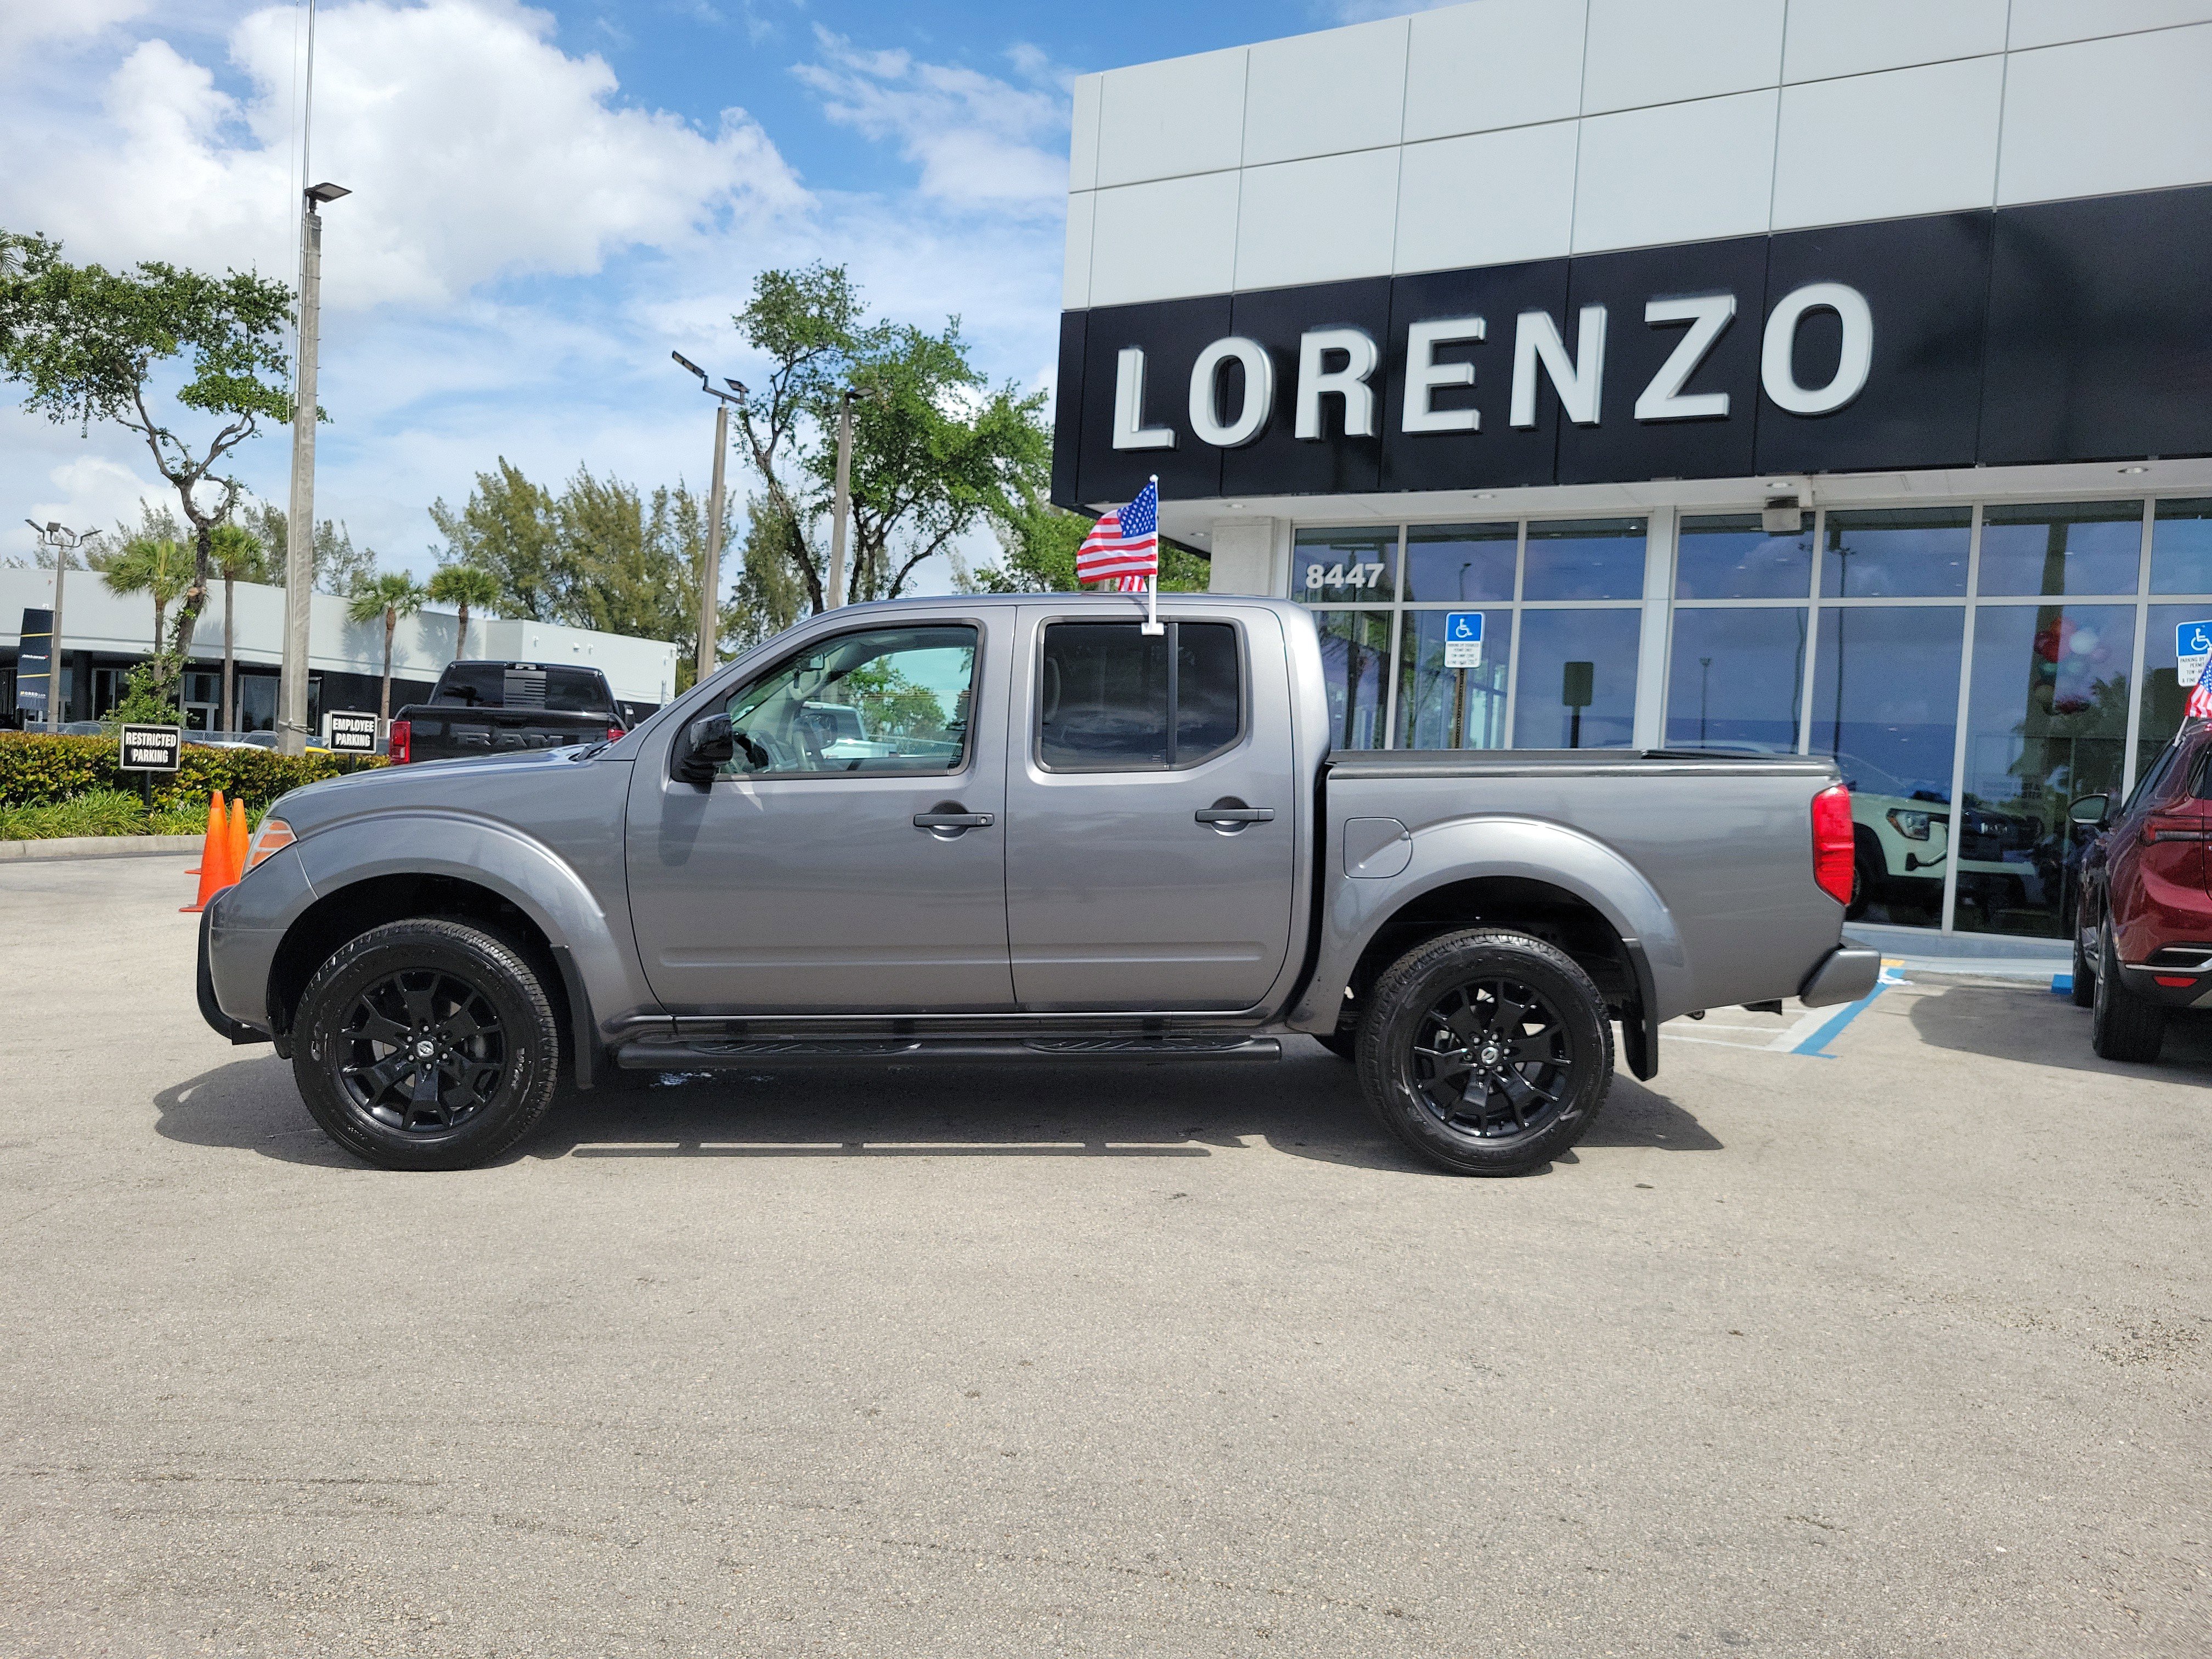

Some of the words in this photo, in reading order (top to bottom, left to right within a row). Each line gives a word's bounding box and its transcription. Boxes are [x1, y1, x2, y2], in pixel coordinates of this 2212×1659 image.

[1112, 283, 1872, 451] LORENZO
[1306, 563, 1385, 589] 8447
[332, 718, 374, 733] EMPLOYEE
[125, 732, 177, 747] RESTRICTED
[335, 732, 370, 747] PARKING
[456, 731, 564, 748] RAM
[132, 748, 168, 763] PARKING
